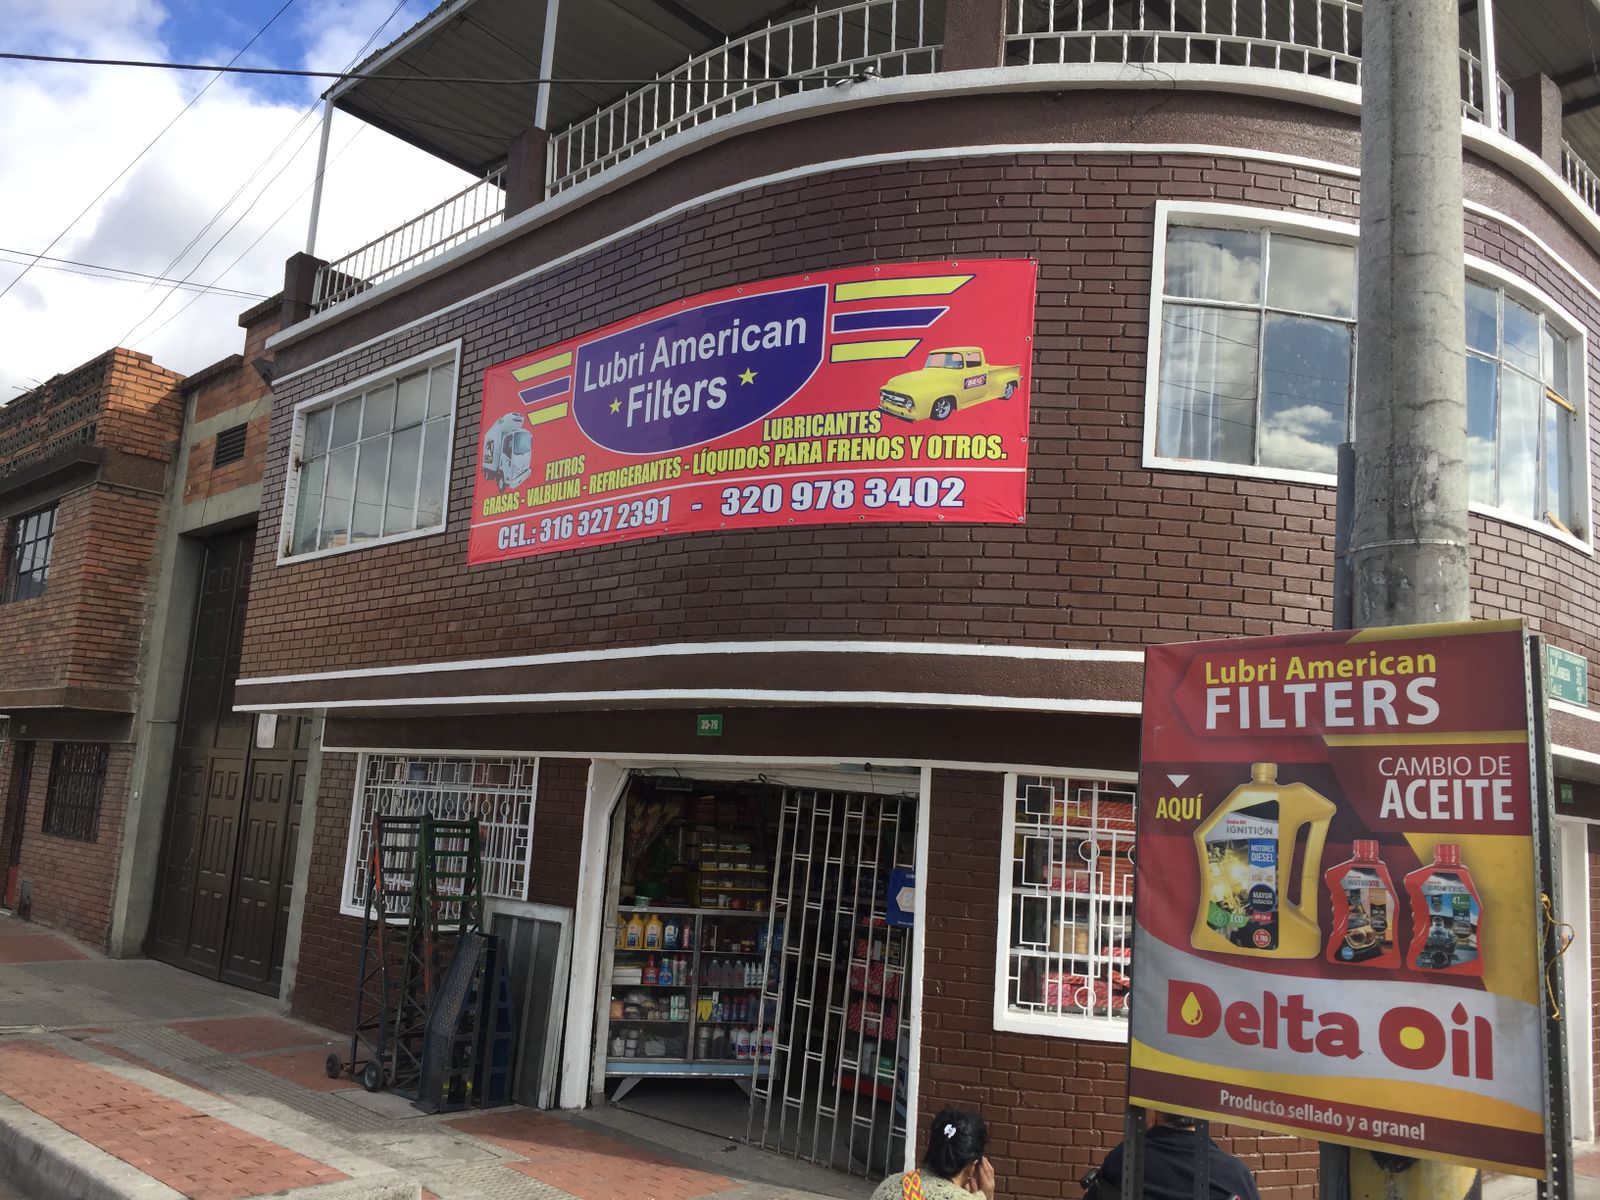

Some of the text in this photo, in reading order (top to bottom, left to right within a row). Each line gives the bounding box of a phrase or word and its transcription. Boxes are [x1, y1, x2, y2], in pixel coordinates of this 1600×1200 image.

[584, 317, 807, 392] Lubri American
[626, 377, 728, 427] Filters
[763, 411, 881, 441] LUBRICANTES
[482, 492, 519, 516] GRASAS
[527, 478, 580, 507] VALBULINA
[589, 456, 682, 495] REFRIGERANTES
[692, 445, 770, 475] LÍQUIDOS
[773, 439, 827, 466] PARA
[827, 435, 905, 464] FRENOS
[903, 436, 923, 459] Y
[927, 435, 1008, 460] OTROS.
[546, 455, 585, 481] FILTROS
[498, 525, 536, 550] CEL.:
[539, 514, 573, 542] 316
[577, 506, 613, 537] 327
[616, 495, 671, 530] 2391
[720, 483, 783, 516] 320
[791, 479, 855, 511] 978
[864, 476, 966, 508] 3402
[1205, 650, 1436, 685] Lubri American
[1205, 677, 1441, 730] FILTERS
[1378, 755, 1512, 777] CAMBIO DE
[1155, 793, 1204, 821] AQUÍ
[1379, 778, 1515, 821] ACEITE
[1167, 979, 1493, 1080] Delta Oil
[1220, 1089, 1426, 1141] Producto sellado y a granel
